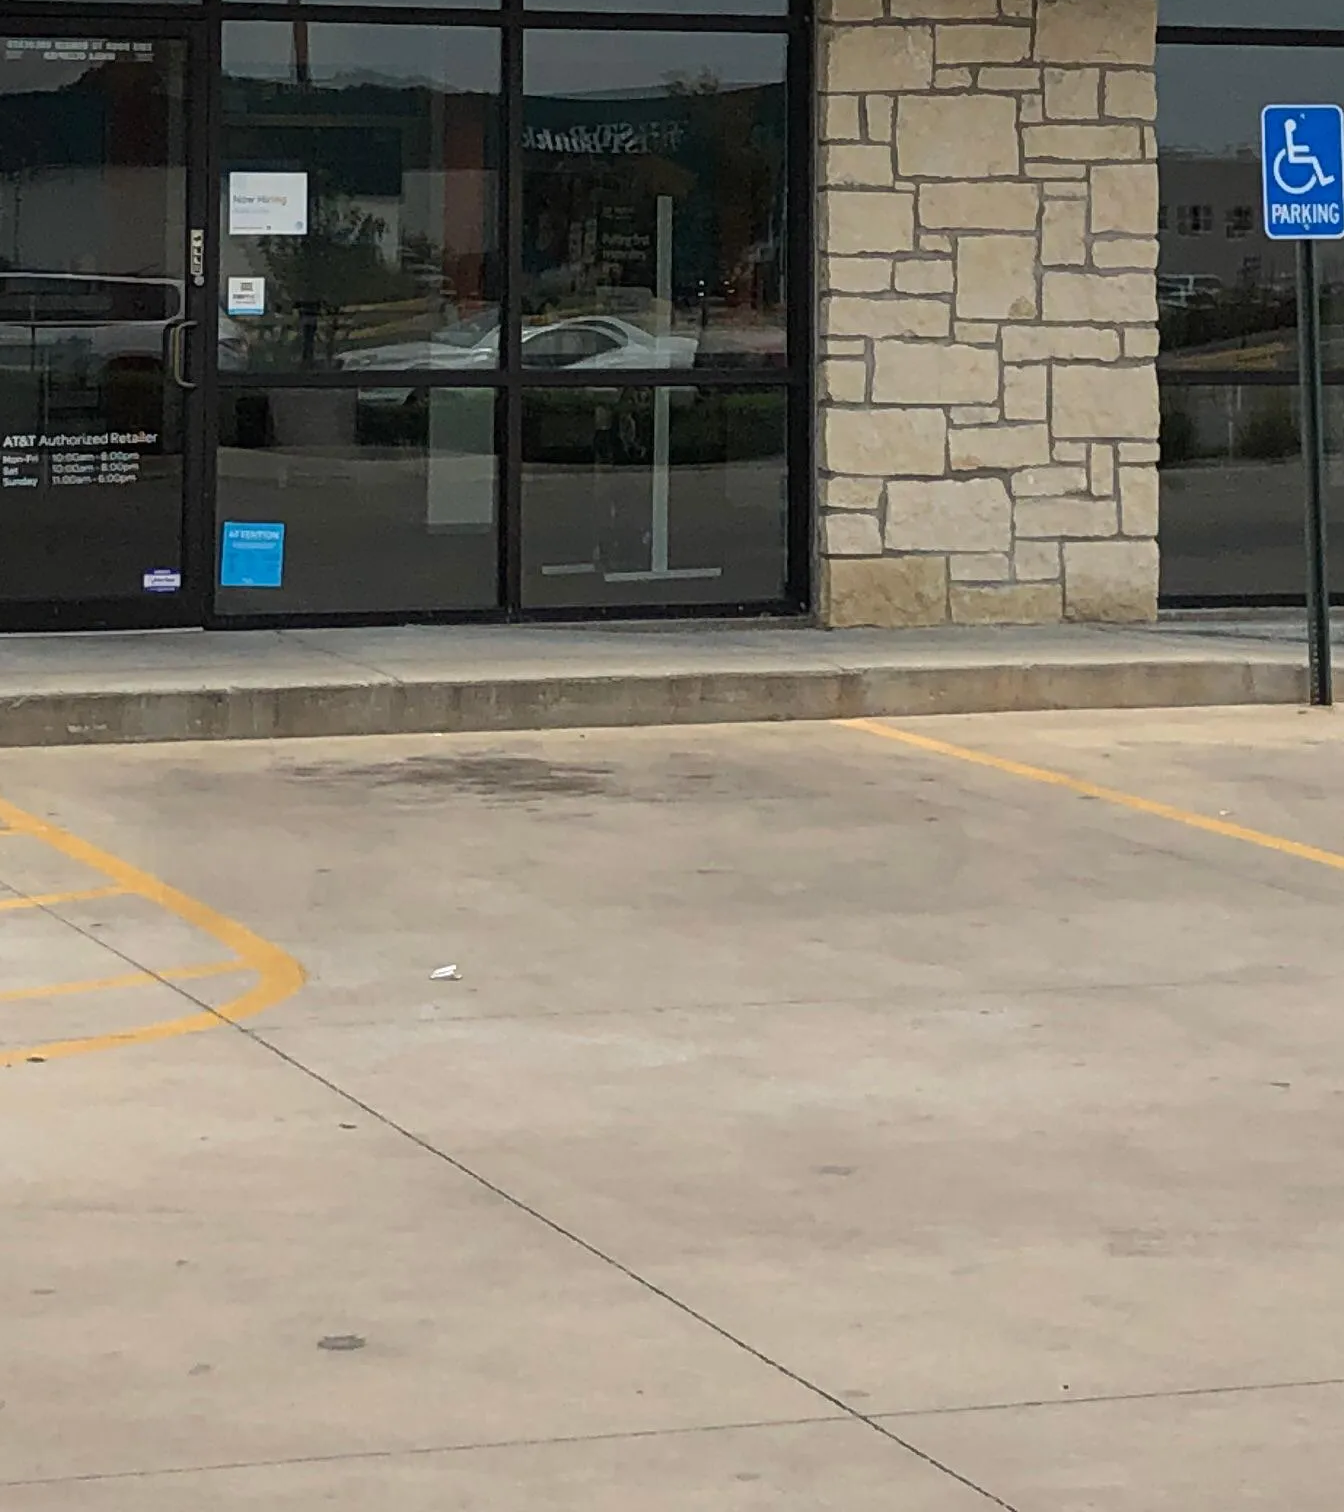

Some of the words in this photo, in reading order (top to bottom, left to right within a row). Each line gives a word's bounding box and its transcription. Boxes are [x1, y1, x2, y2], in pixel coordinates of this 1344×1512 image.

[232, 194, 254, 204] Now
[1271, 202, 1340, 225] PARKING
[2, 434, 37, 448] AT&T
[38, 433, 109, 447] Authorized
[110, 430, 158, 445] Retailer
[2, 466, 19, 476] Sat
[2, 477, 39, 487] Sunday
